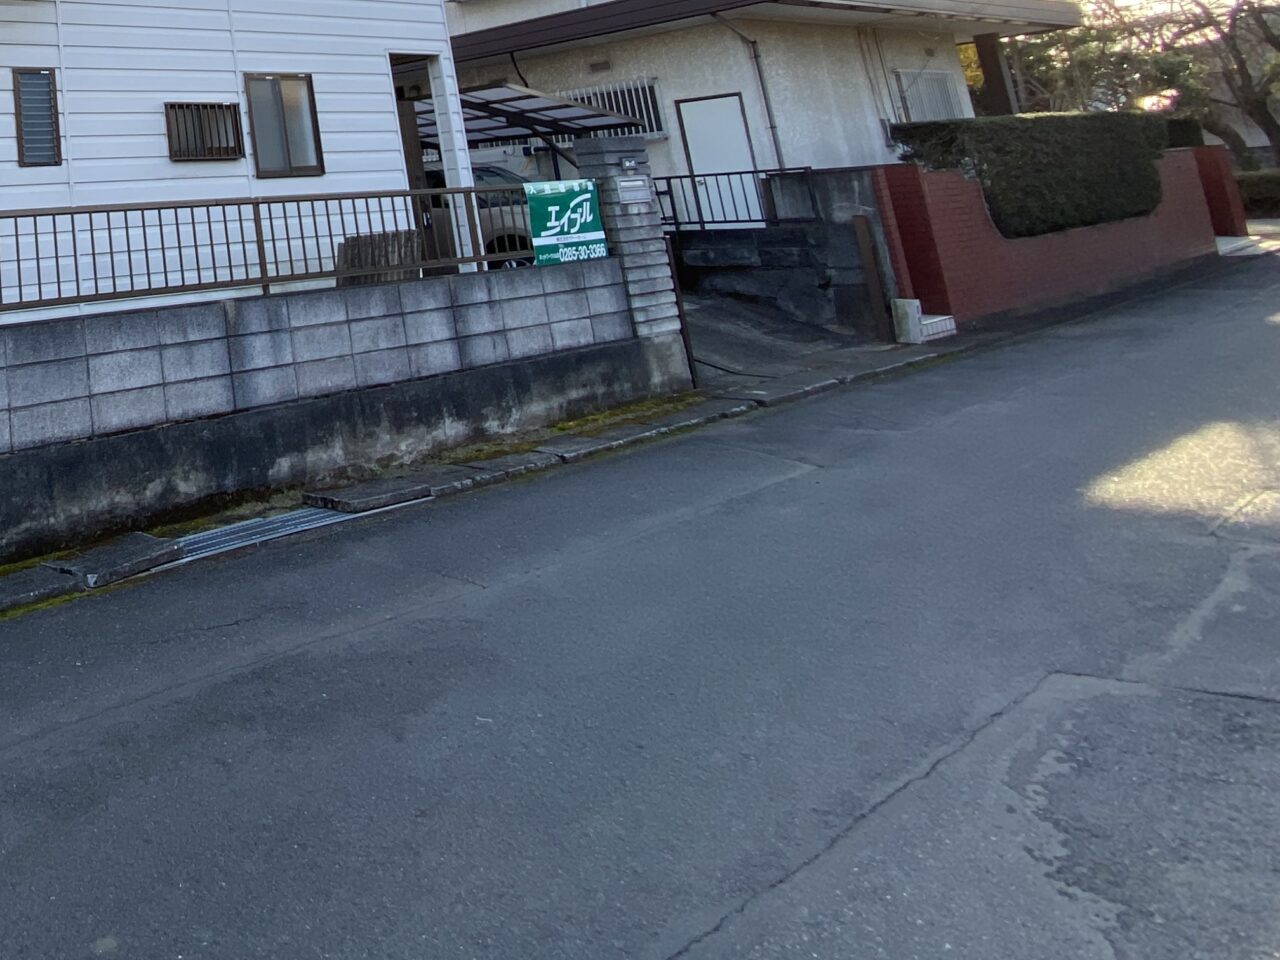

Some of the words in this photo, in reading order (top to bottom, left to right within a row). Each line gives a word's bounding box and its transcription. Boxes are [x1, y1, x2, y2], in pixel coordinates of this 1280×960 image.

[541, 193, 593, 236] エイブル
[559, 243, 607, 262] 0285-30-3366
